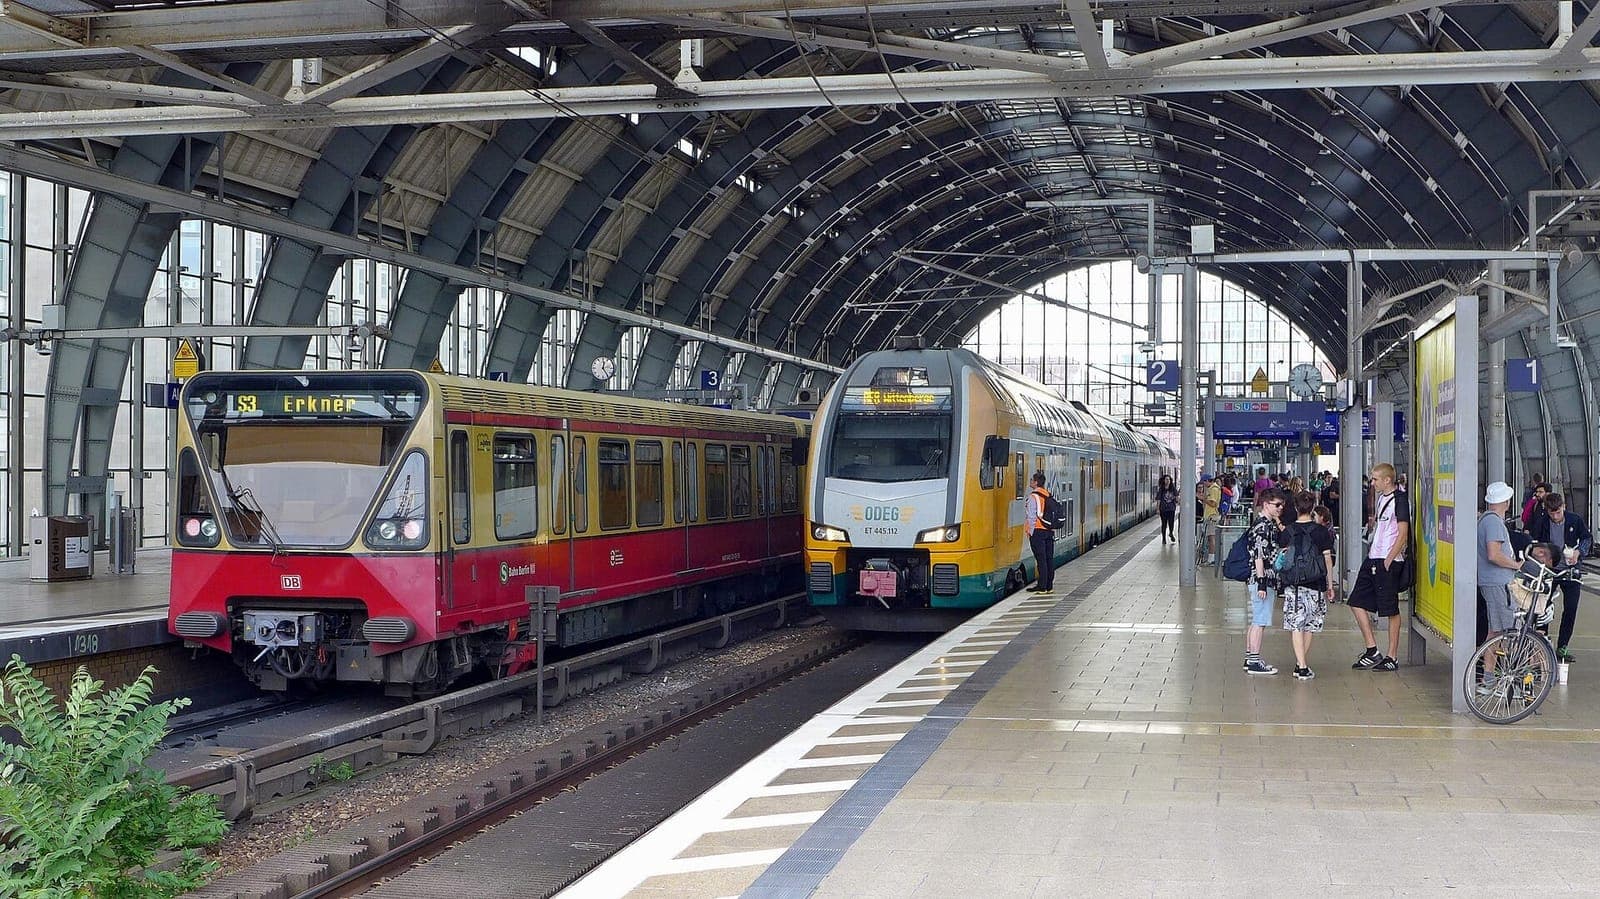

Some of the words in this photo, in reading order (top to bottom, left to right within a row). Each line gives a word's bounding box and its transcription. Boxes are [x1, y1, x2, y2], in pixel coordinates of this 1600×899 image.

[708, 371, 718, 386] 3
[1151, 361, 1166, 384] 2
[1526, 360, 1537, 384] 1
[238, 395, 257, 412] S3
[284, 395, 356, 412] Erkner
[1243, 402, 1250, 411] U
[865, 506, 899, 521] ODEG
[865, 527, 872, 535] ET
[284, 577, 299, 588] DB
